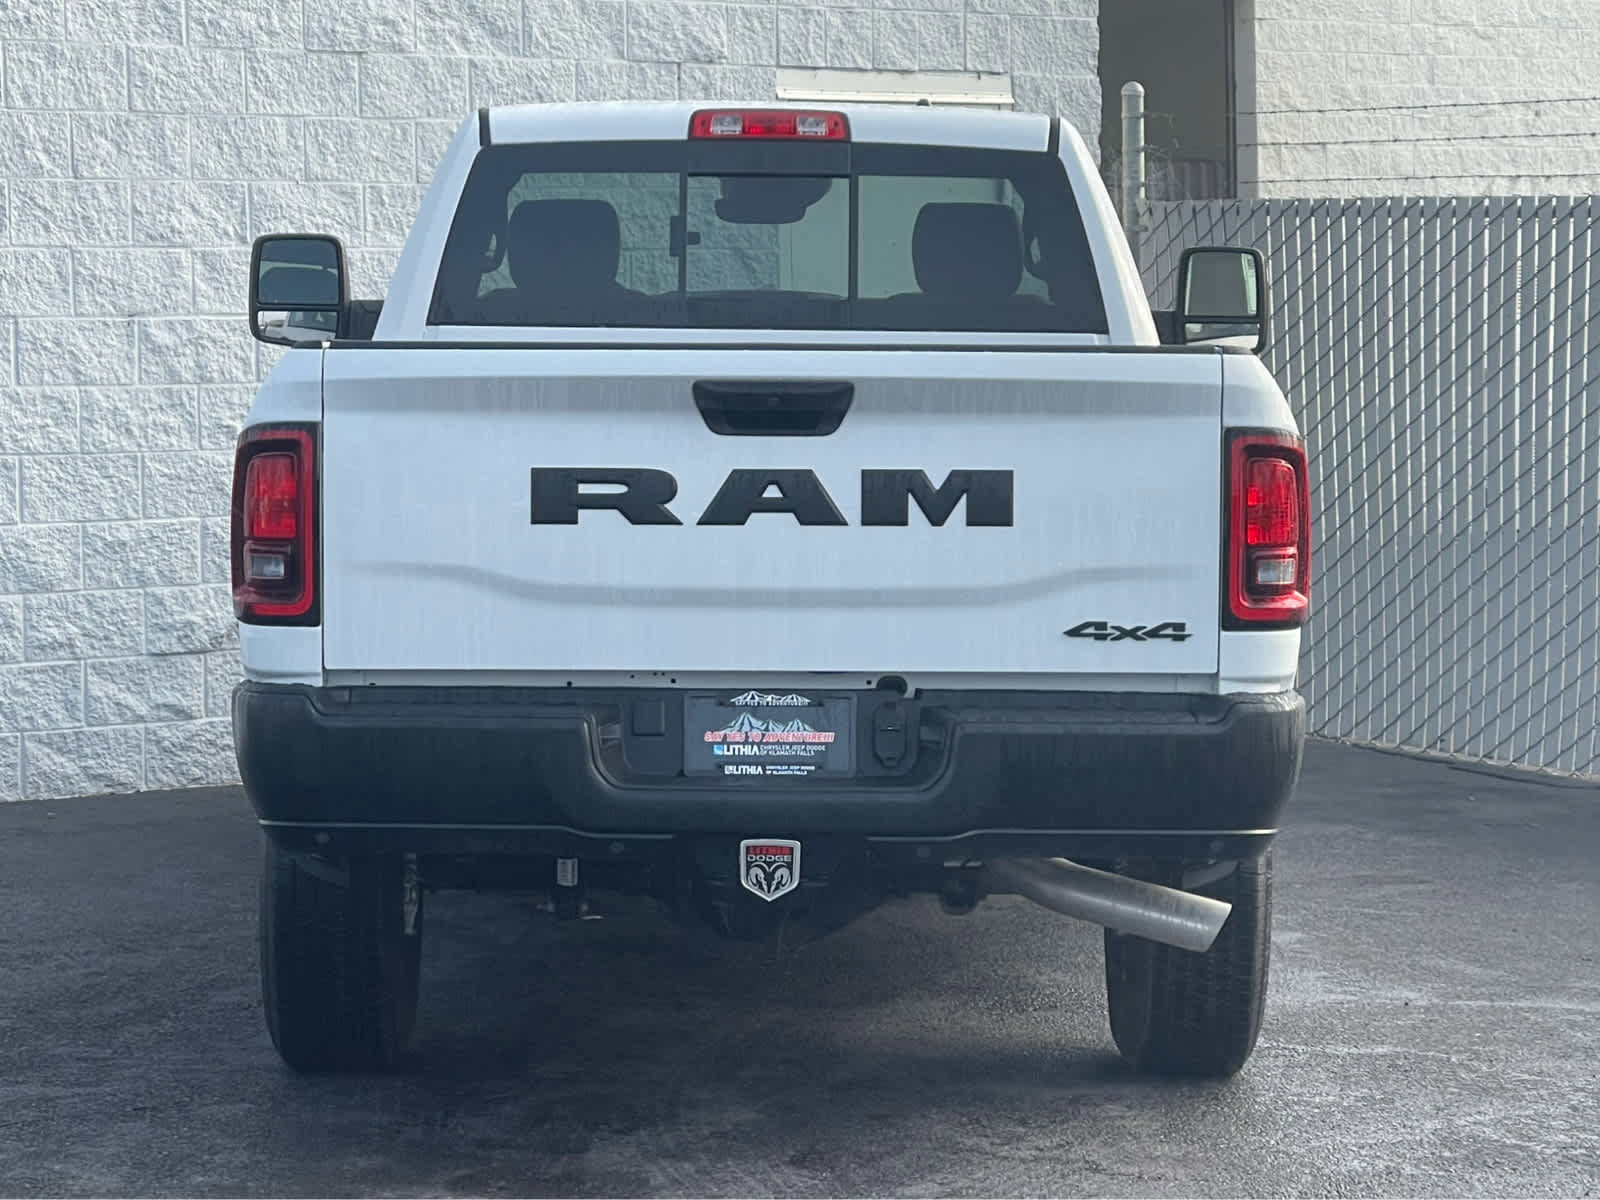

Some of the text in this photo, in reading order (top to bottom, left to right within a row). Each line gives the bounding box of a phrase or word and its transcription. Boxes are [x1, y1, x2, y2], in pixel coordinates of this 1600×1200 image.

[531, 467, 1015, 527] RAM
[1063, 621, 1192, 641] 4x4
[704, 731, 724, 742] SAY
[726, 731, 745, 742] YES
[748, 732, 762, 742] TO
[724, 744, 759, 755] LITHIA
[733, 765, 763, 775] LITHIA
